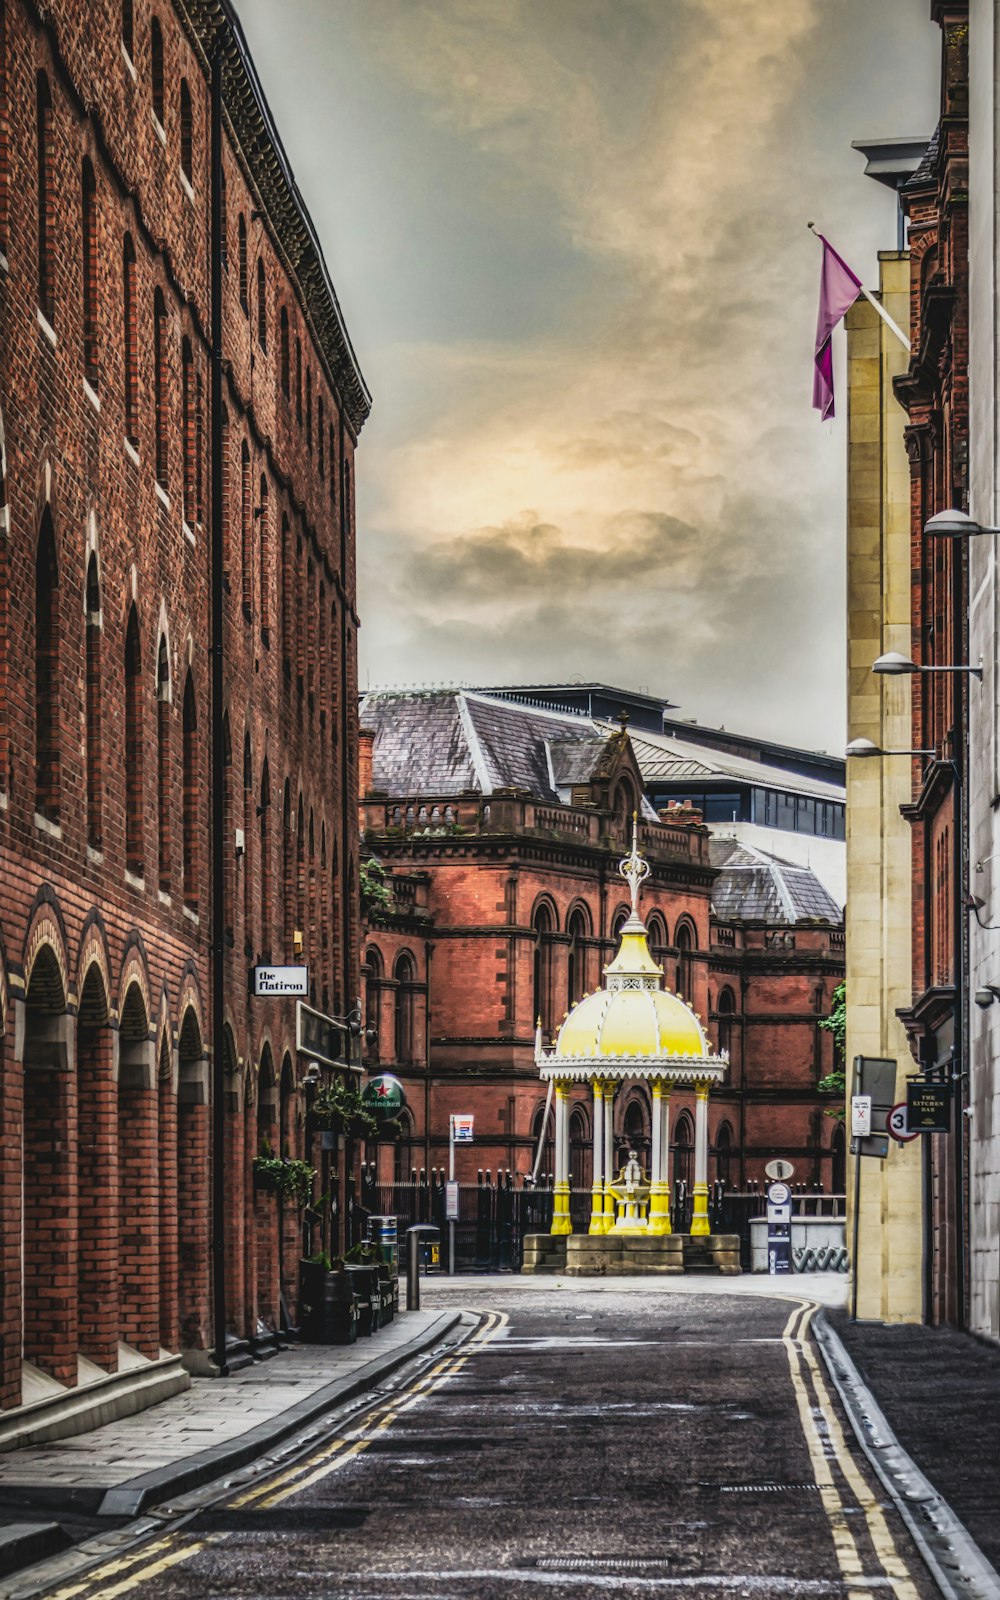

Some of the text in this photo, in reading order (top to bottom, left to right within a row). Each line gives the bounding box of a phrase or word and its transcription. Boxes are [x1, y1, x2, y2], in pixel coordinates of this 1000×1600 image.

[259, 971, 276, 980] the
[259, 981, 303, 990] flatiron
[365, 1100, 401, 1108] Heineken
[892, 1114, 904, 1129] 3
